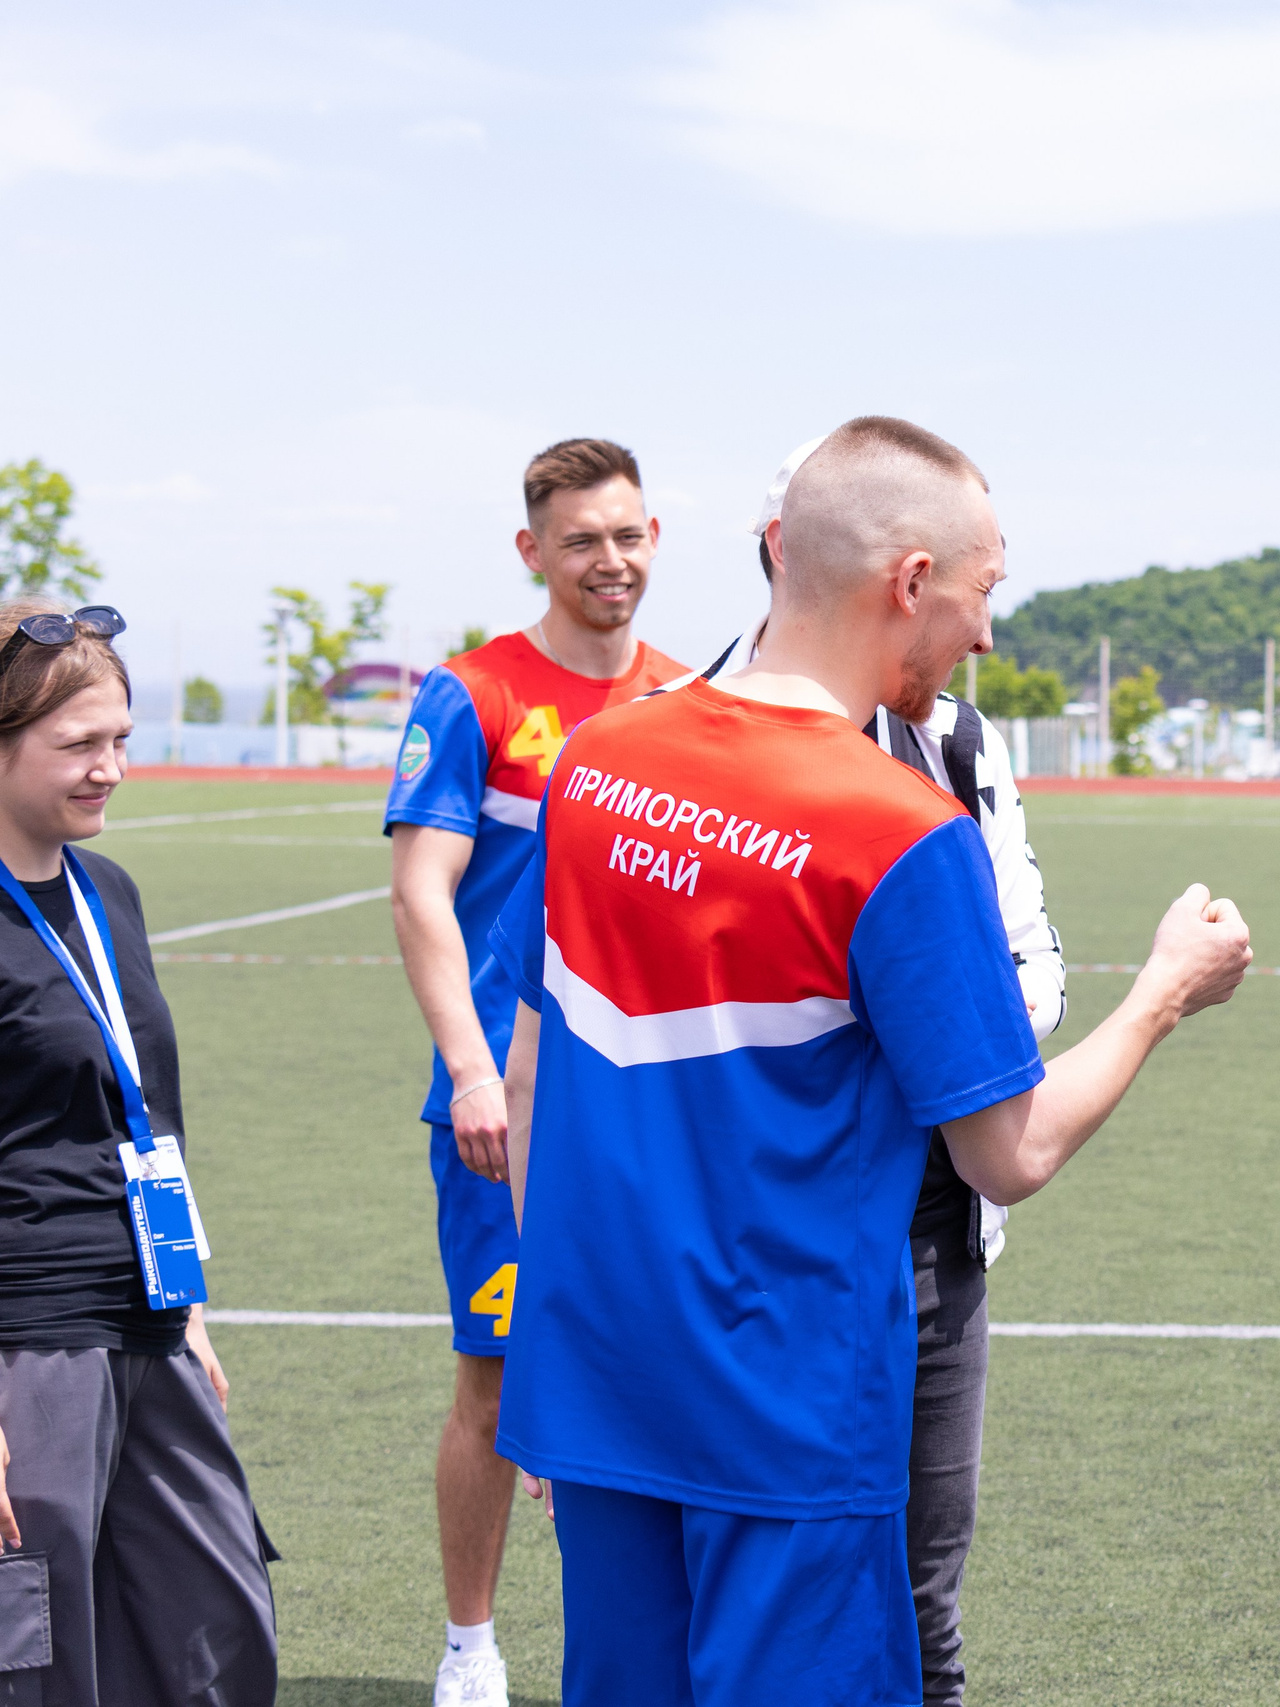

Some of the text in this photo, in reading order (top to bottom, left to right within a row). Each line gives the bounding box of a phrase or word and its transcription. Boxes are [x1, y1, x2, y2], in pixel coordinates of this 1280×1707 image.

[508, 705, 567, 777] 4
[564, 765, 813, 879] ПРИМОРСКИЙ
[608, 833, 702, 897] КРАЙ
[469, 1263, 518, 1337] 4
